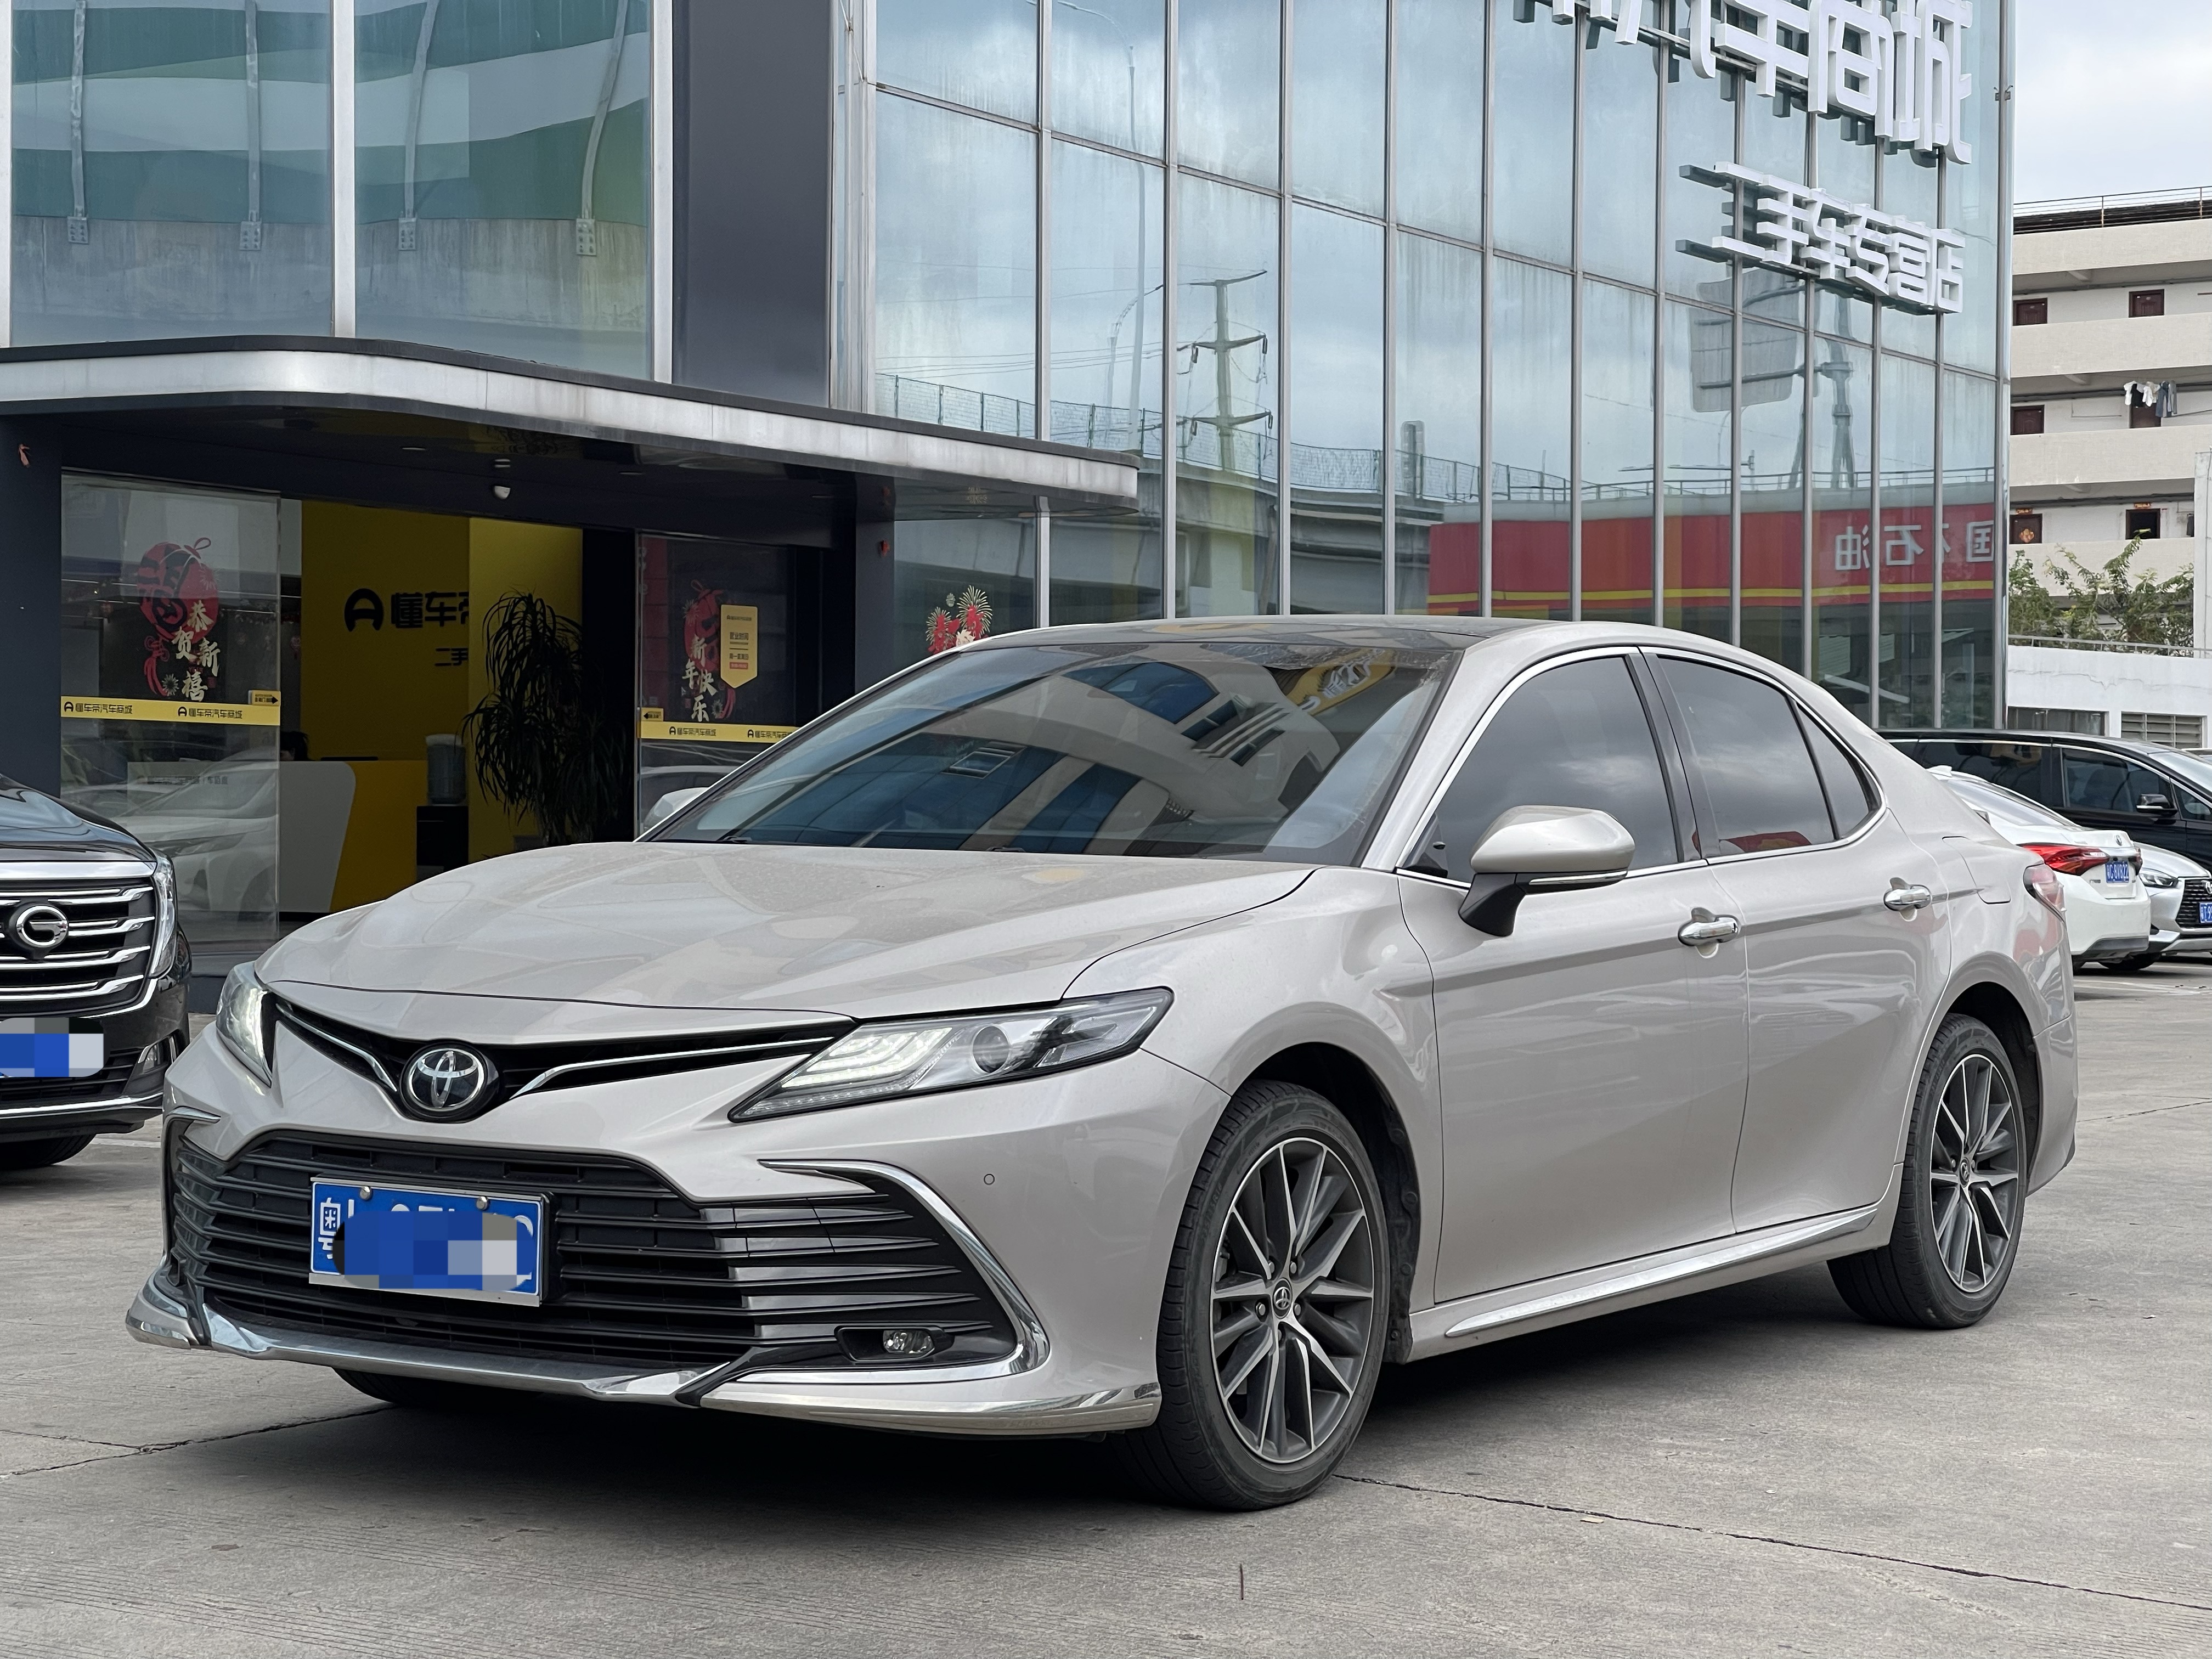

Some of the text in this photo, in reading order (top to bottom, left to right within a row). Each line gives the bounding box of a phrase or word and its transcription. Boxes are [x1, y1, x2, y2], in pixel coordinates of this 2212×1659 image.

[1712, 161, 1965, 313] 二手车专营店
[171, 600, 221, 702] 恭贺新禧
[435, 647, 469, 667] 二手
[681, 634, 719, 722] 新年快乐
